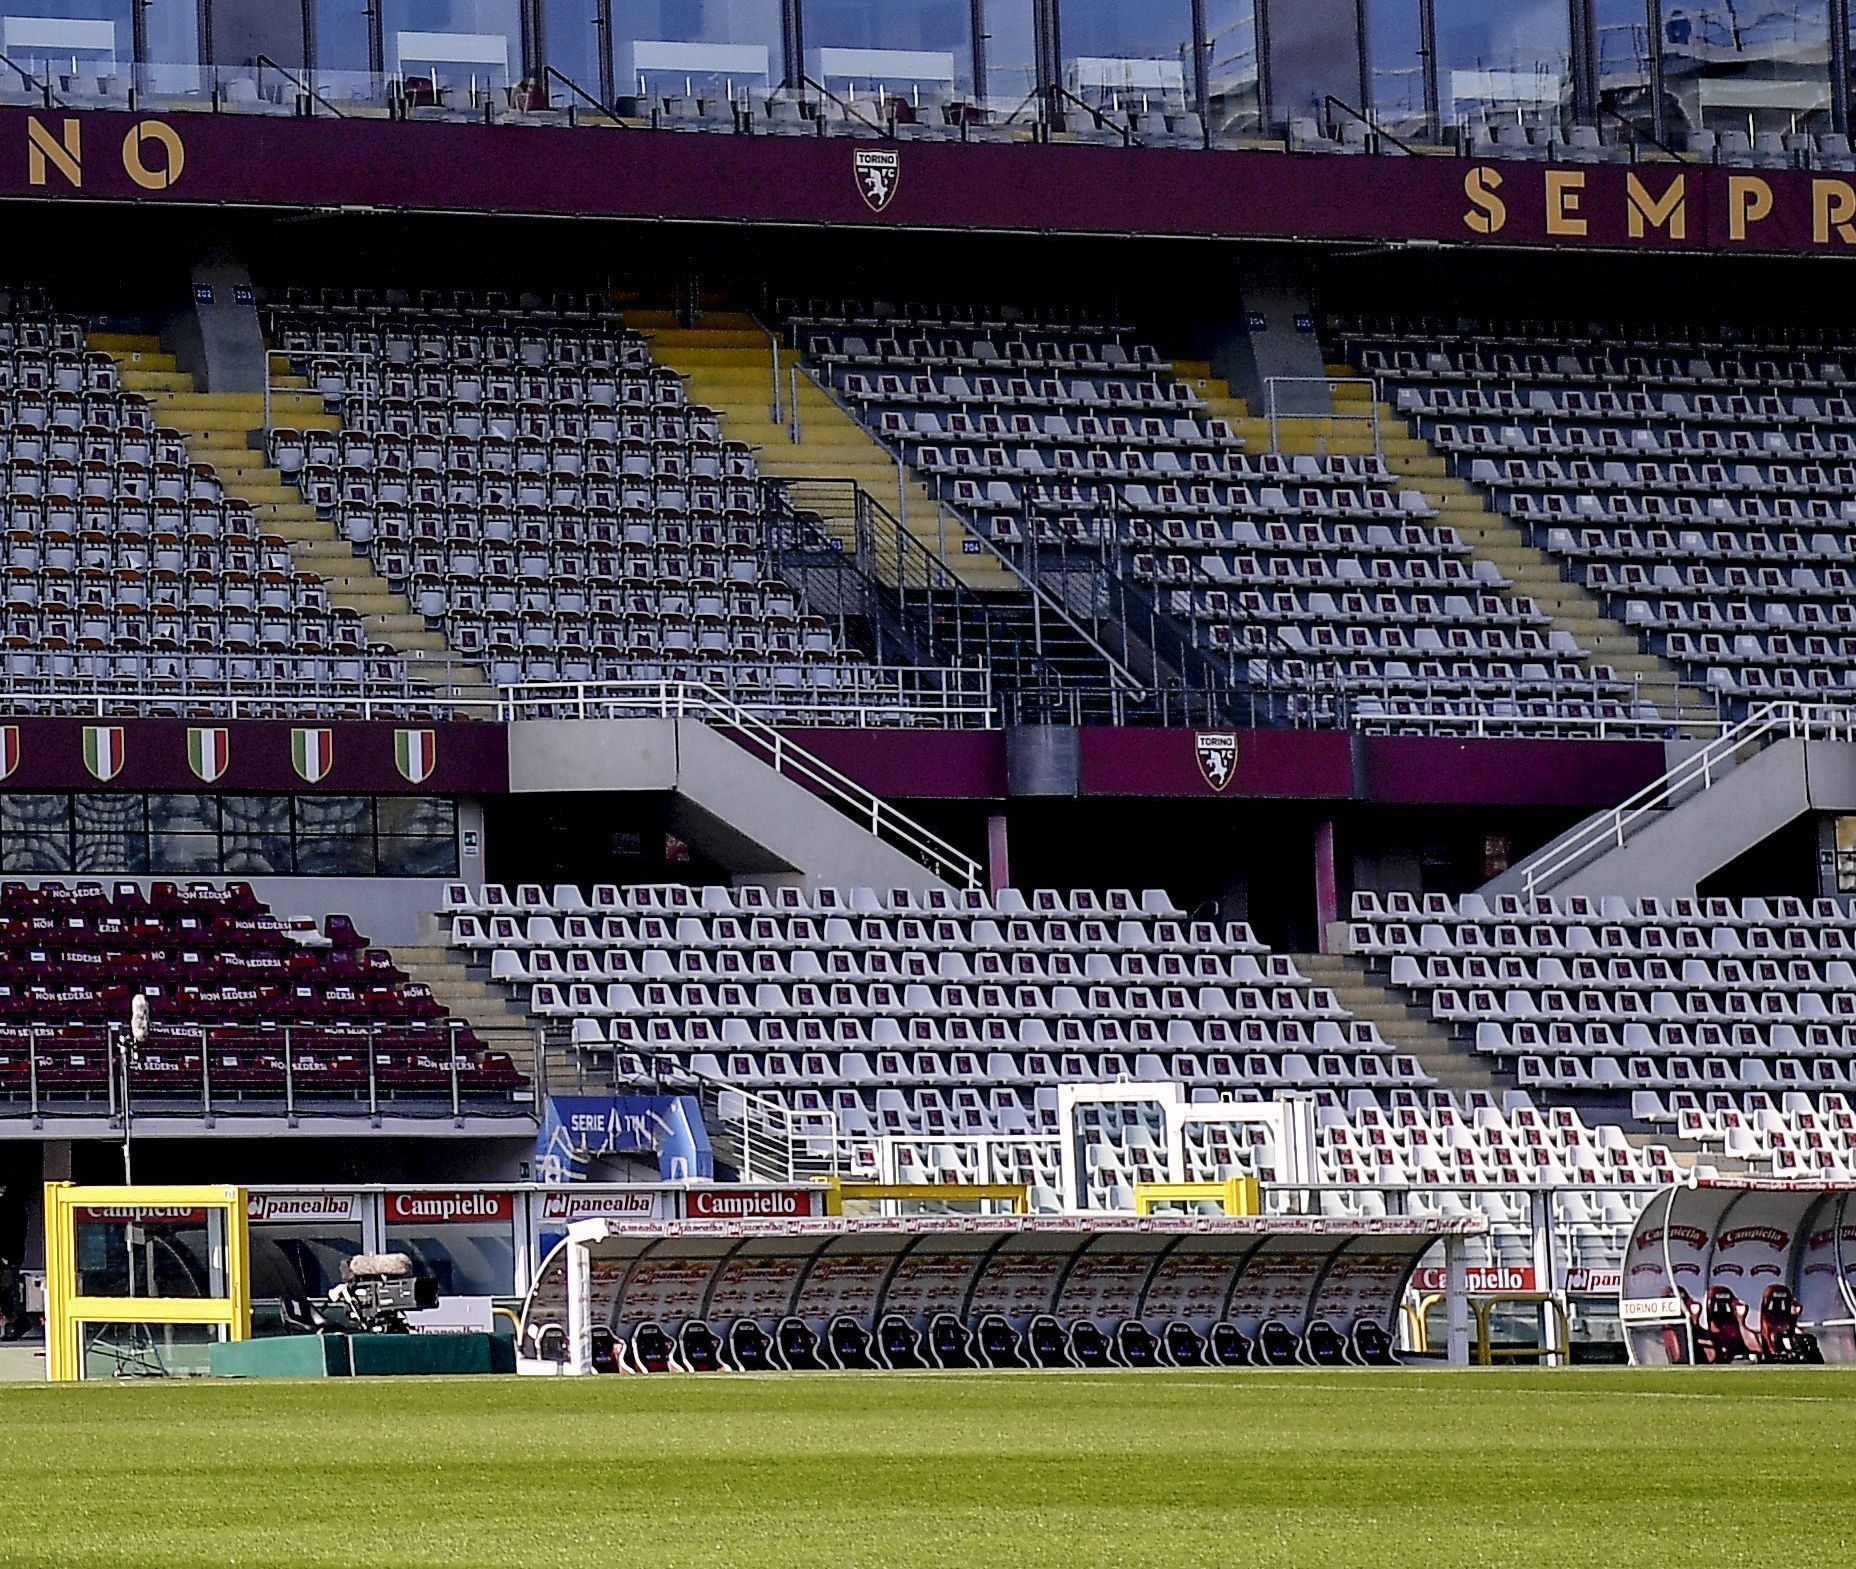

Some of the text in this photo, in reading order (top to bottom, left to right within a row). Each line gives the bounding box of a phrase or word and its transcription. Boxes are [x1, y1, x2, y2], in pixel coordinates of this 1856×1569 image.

[858, 153, 894, 165] TORINO
[881, 168, 895, 179] FC
[1199, 737, 1233, 746] TORINO
[1221, 750, 1233, 759] FC
[569, 1112, 603, 1132] SERIE
[265, 1196, 351, 1219] panealba
[395, 1193, 500, 1218] Campiello
[571, 1193, 649, 1216] panealba
[696, 1191, 797, 1214] Campiello
[1726, 1228, 1784, 1243] Campiello
[1625, 1301, 1658, 1316] TORINO
